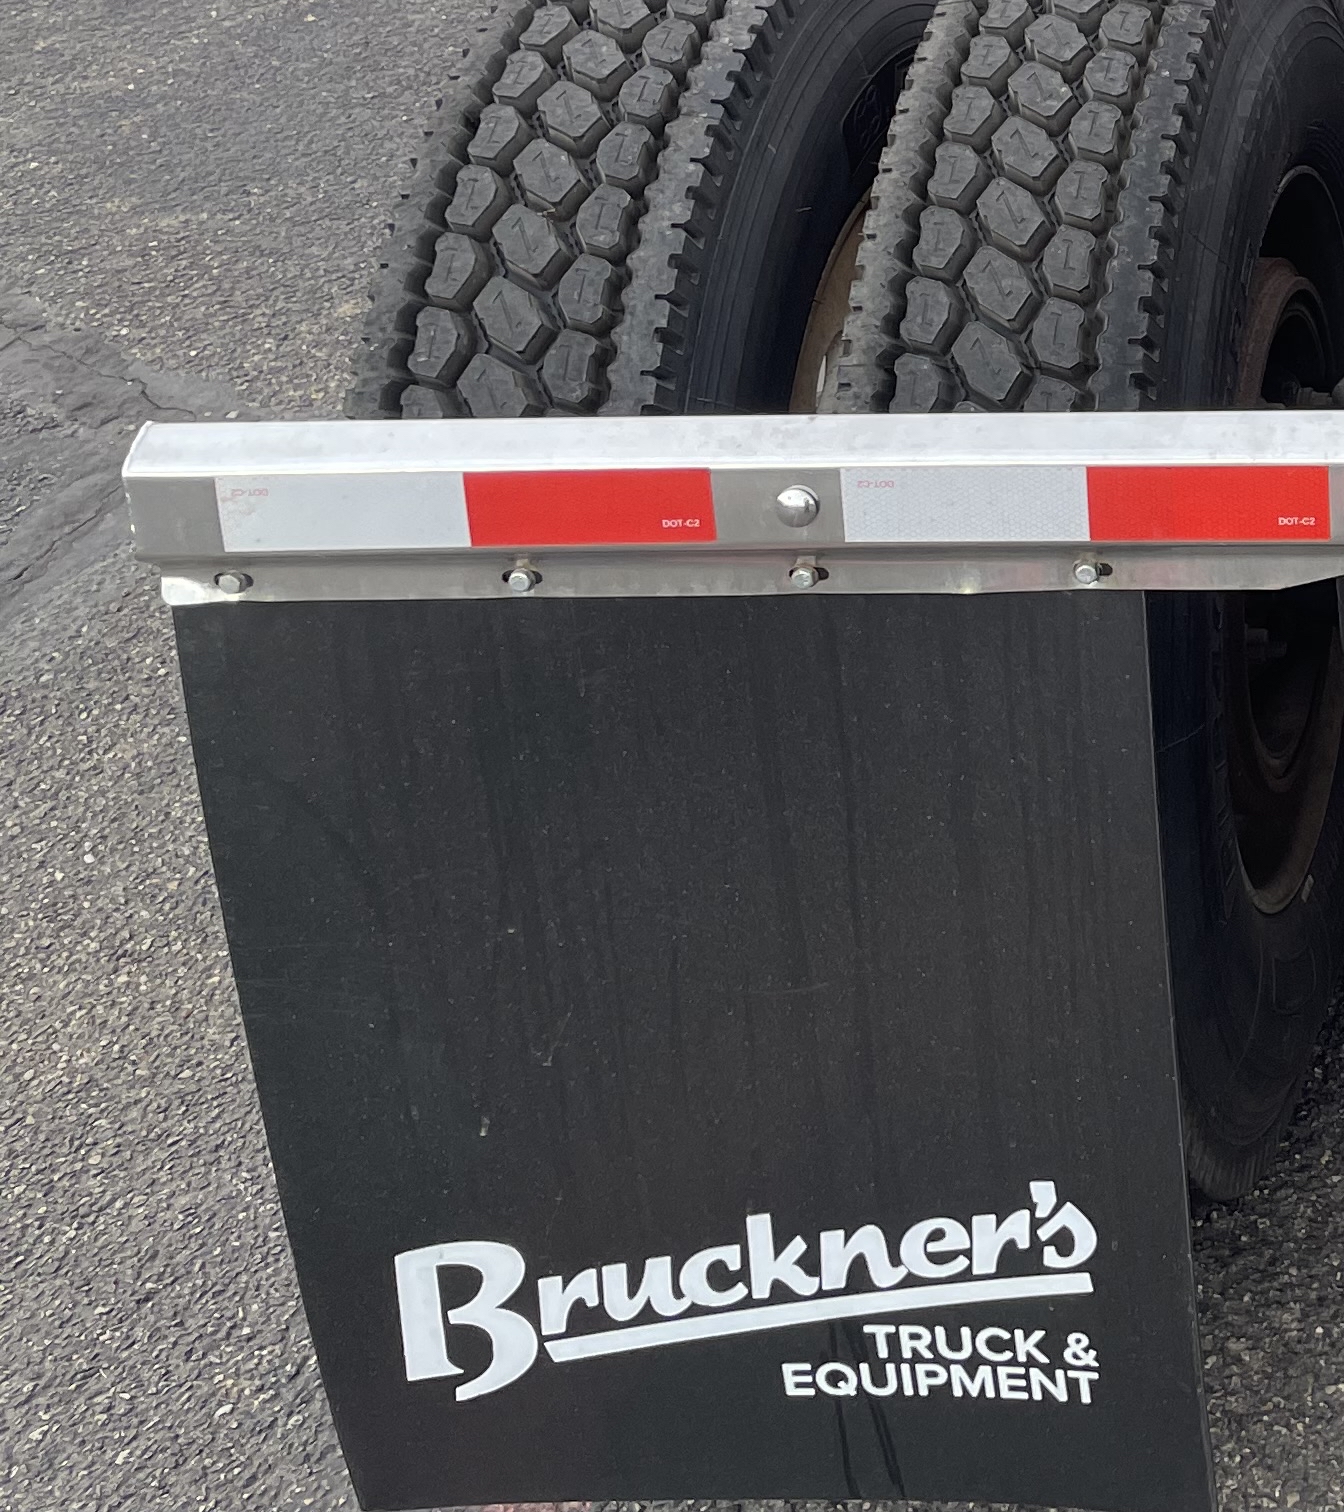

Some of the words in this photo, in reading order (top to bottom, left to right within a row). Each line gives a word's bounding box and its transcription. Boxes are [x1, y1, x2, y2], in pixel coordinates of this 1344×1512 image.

[857, 480, 895, 488] DOT-C2
[661, 518, 701, 528] DOT-C2
[1277, 516, 1316, 526] DOT-C2
[395, 1180, 1098, 1402] Bruckner's
[863, 1324, 1050, 1364] TRUCK
[1063, 1332, 1100, 1367] &
[782, 1362, 1100, 1404] EQUIPMENT
